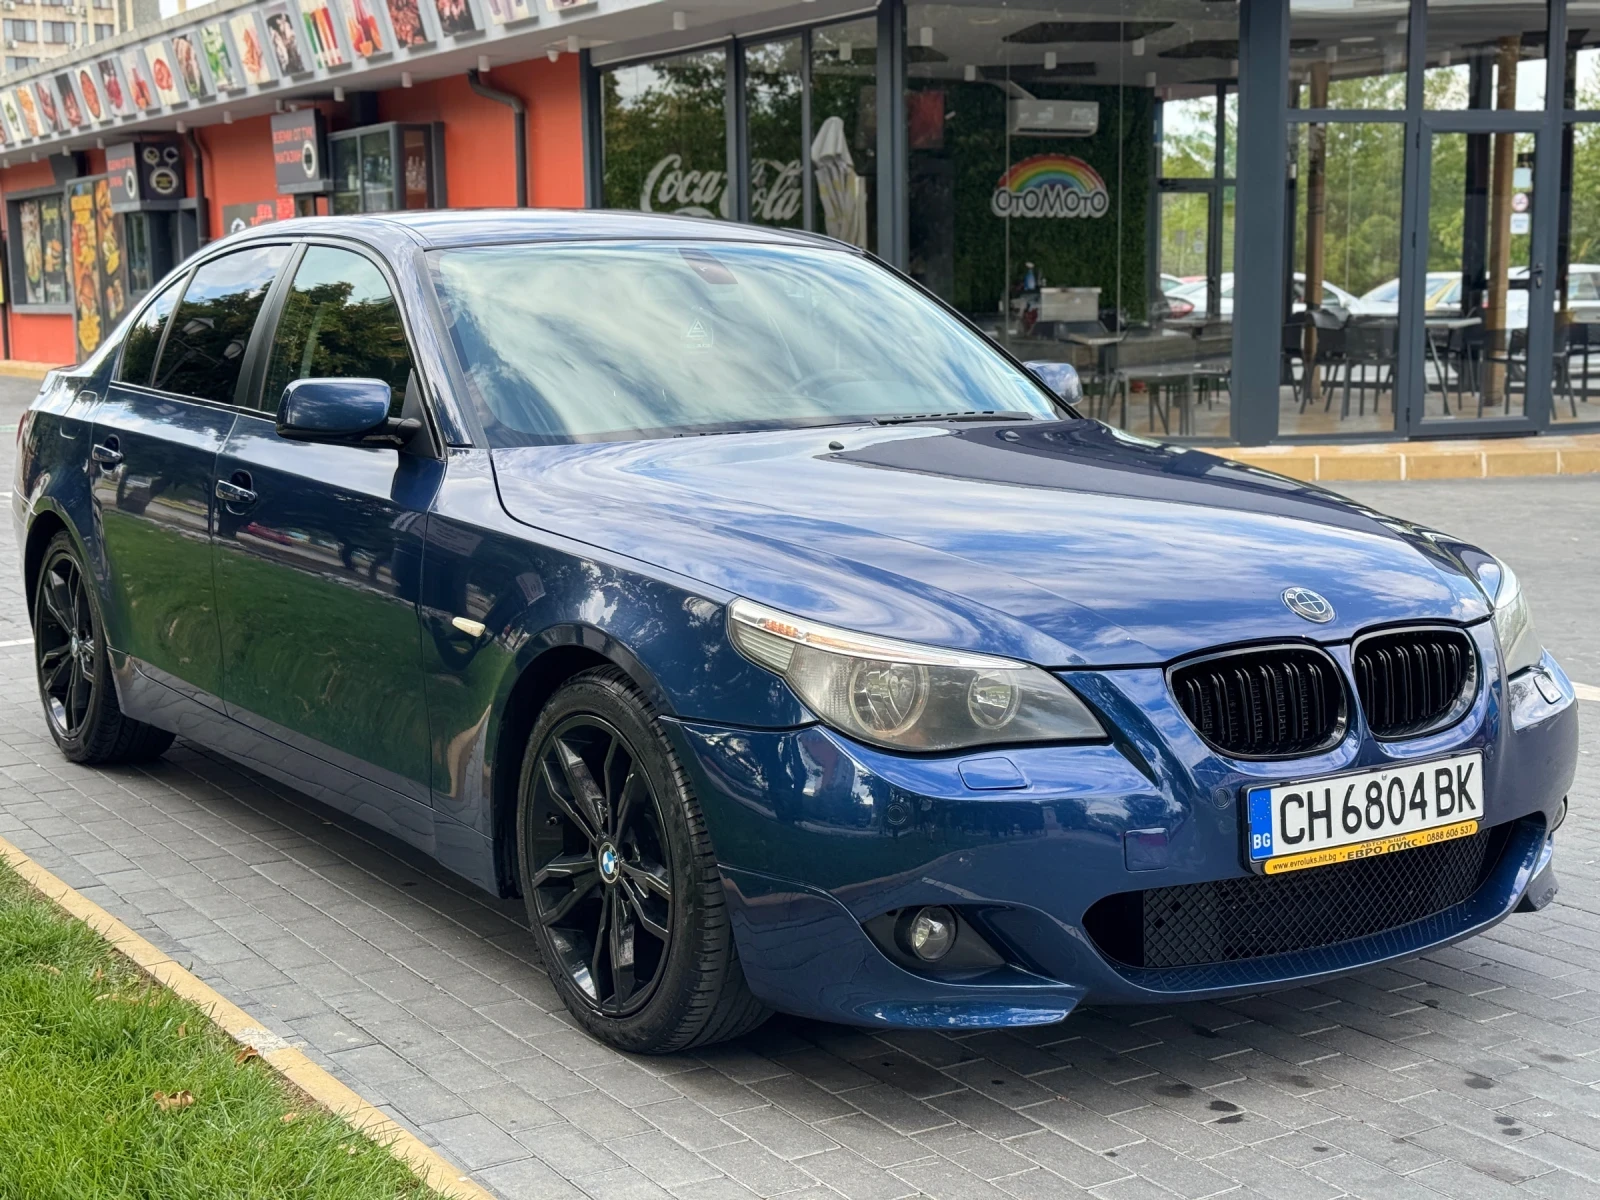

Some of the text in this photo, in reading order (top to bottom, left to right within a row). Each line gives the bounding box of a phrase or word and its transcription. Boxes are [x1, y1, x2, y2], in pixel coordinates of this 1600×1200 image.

[1341, 771, 1429, 835] 6804
[1253, 832, 1272, 850] BG
[1426, 824, 1473, 842] 0888 606 537
[1347, 838, 1418, 860] ЕВРО ЛУКС
